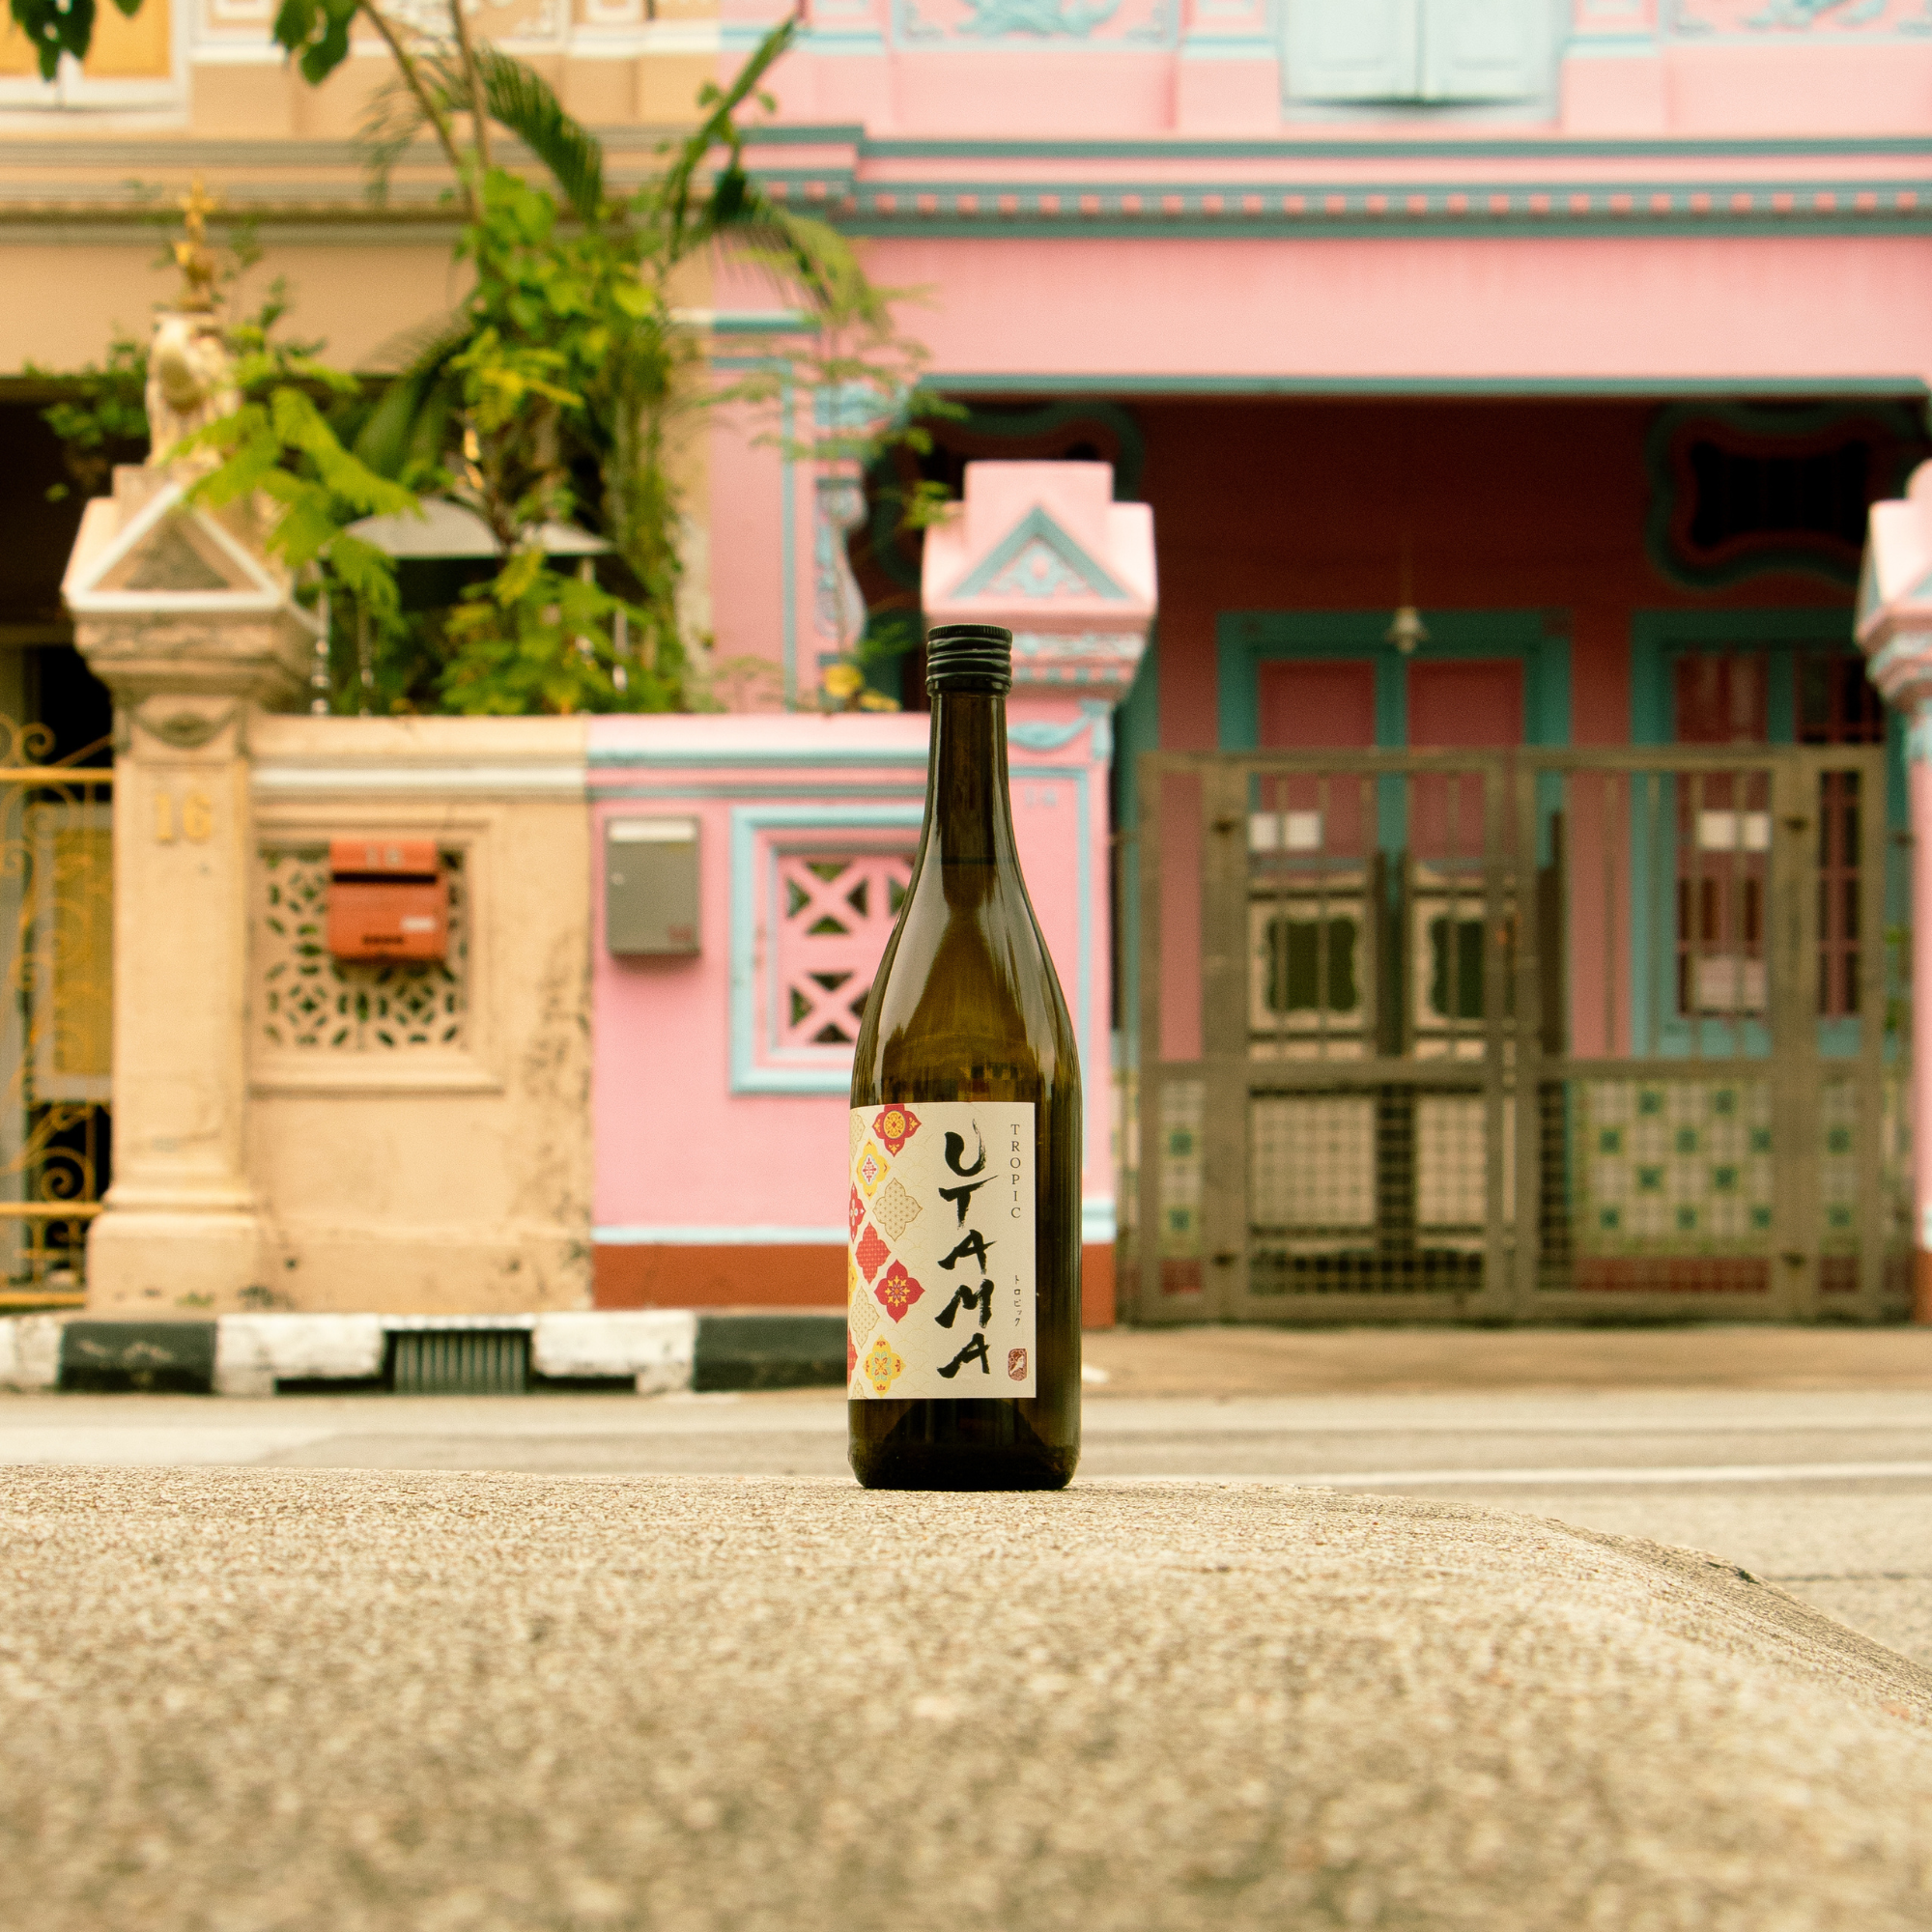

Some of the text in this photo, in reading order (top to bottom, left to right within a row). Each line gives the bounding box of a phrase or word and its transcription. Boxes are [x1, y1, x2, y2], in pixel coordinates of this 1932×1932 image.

[156, 792, 213, 840] 16
[1009, 1123, 1022, 1219] TROPIC
[934, 1118, 999, 1378] UTAMA
